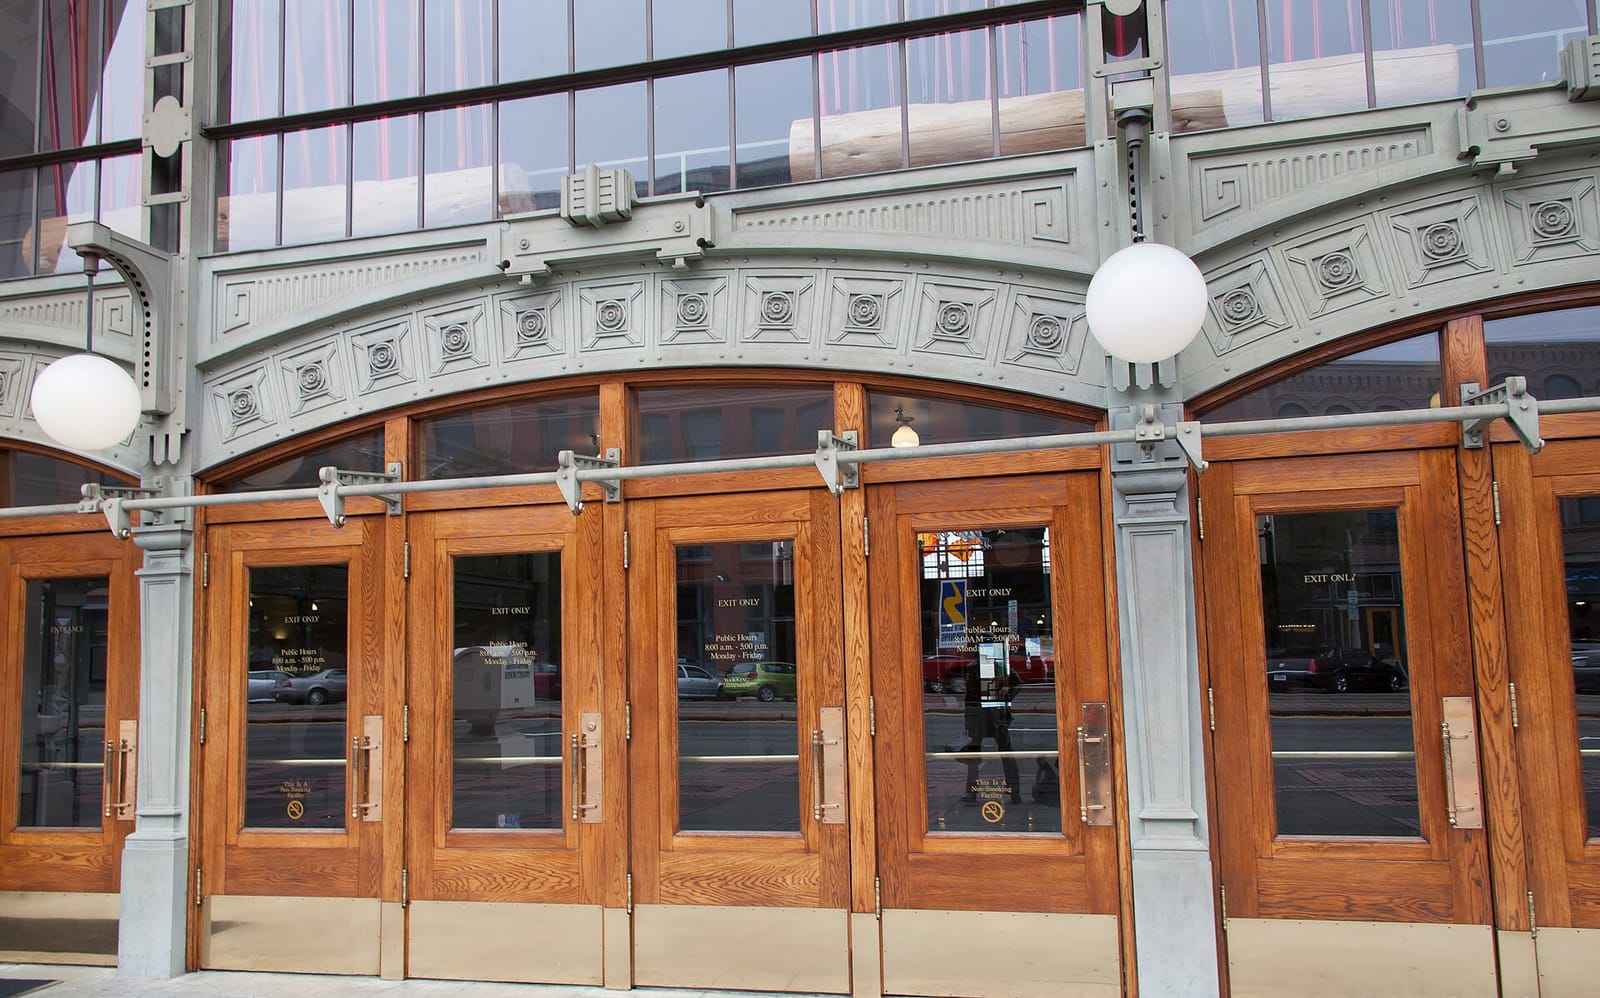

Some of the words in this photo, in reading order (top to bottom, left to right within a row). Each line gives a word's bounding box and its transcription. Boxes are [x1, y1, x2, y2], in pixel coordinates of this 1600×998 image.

[1304, 574, 1328, 583] EXIT
[966, 589, 987, 597] EXIT
[989, 588, 1012, 597] ONLY
[718, 599, 737, 607] EXIT
[739, 598, 760, 606] ONLY
[492, 607, 509, 615] EXIT
[511, 606, 531, 614] ONLY
[284, 616, 300, 624] EXIT
[302, 615, 320, 623] ONLY
[963, 626, 986, 634] Public
[989, 625, 1012, 633] Hours
[715, 634, 736, 642] Public
[737, 633, 758, 641] Hours
[489, 640, 508, 648] Public
[509, 640, 528, 648] Hours
[281, 648, 299, 656] Public
[710, 652, 737, 661] Monday
[742, 651, 763, 660] Friday
[484, 658, 508, 667] Monday
[513, 658, 533, 666] Friday
[971, 785, 1013, 793] Non-Smoking
